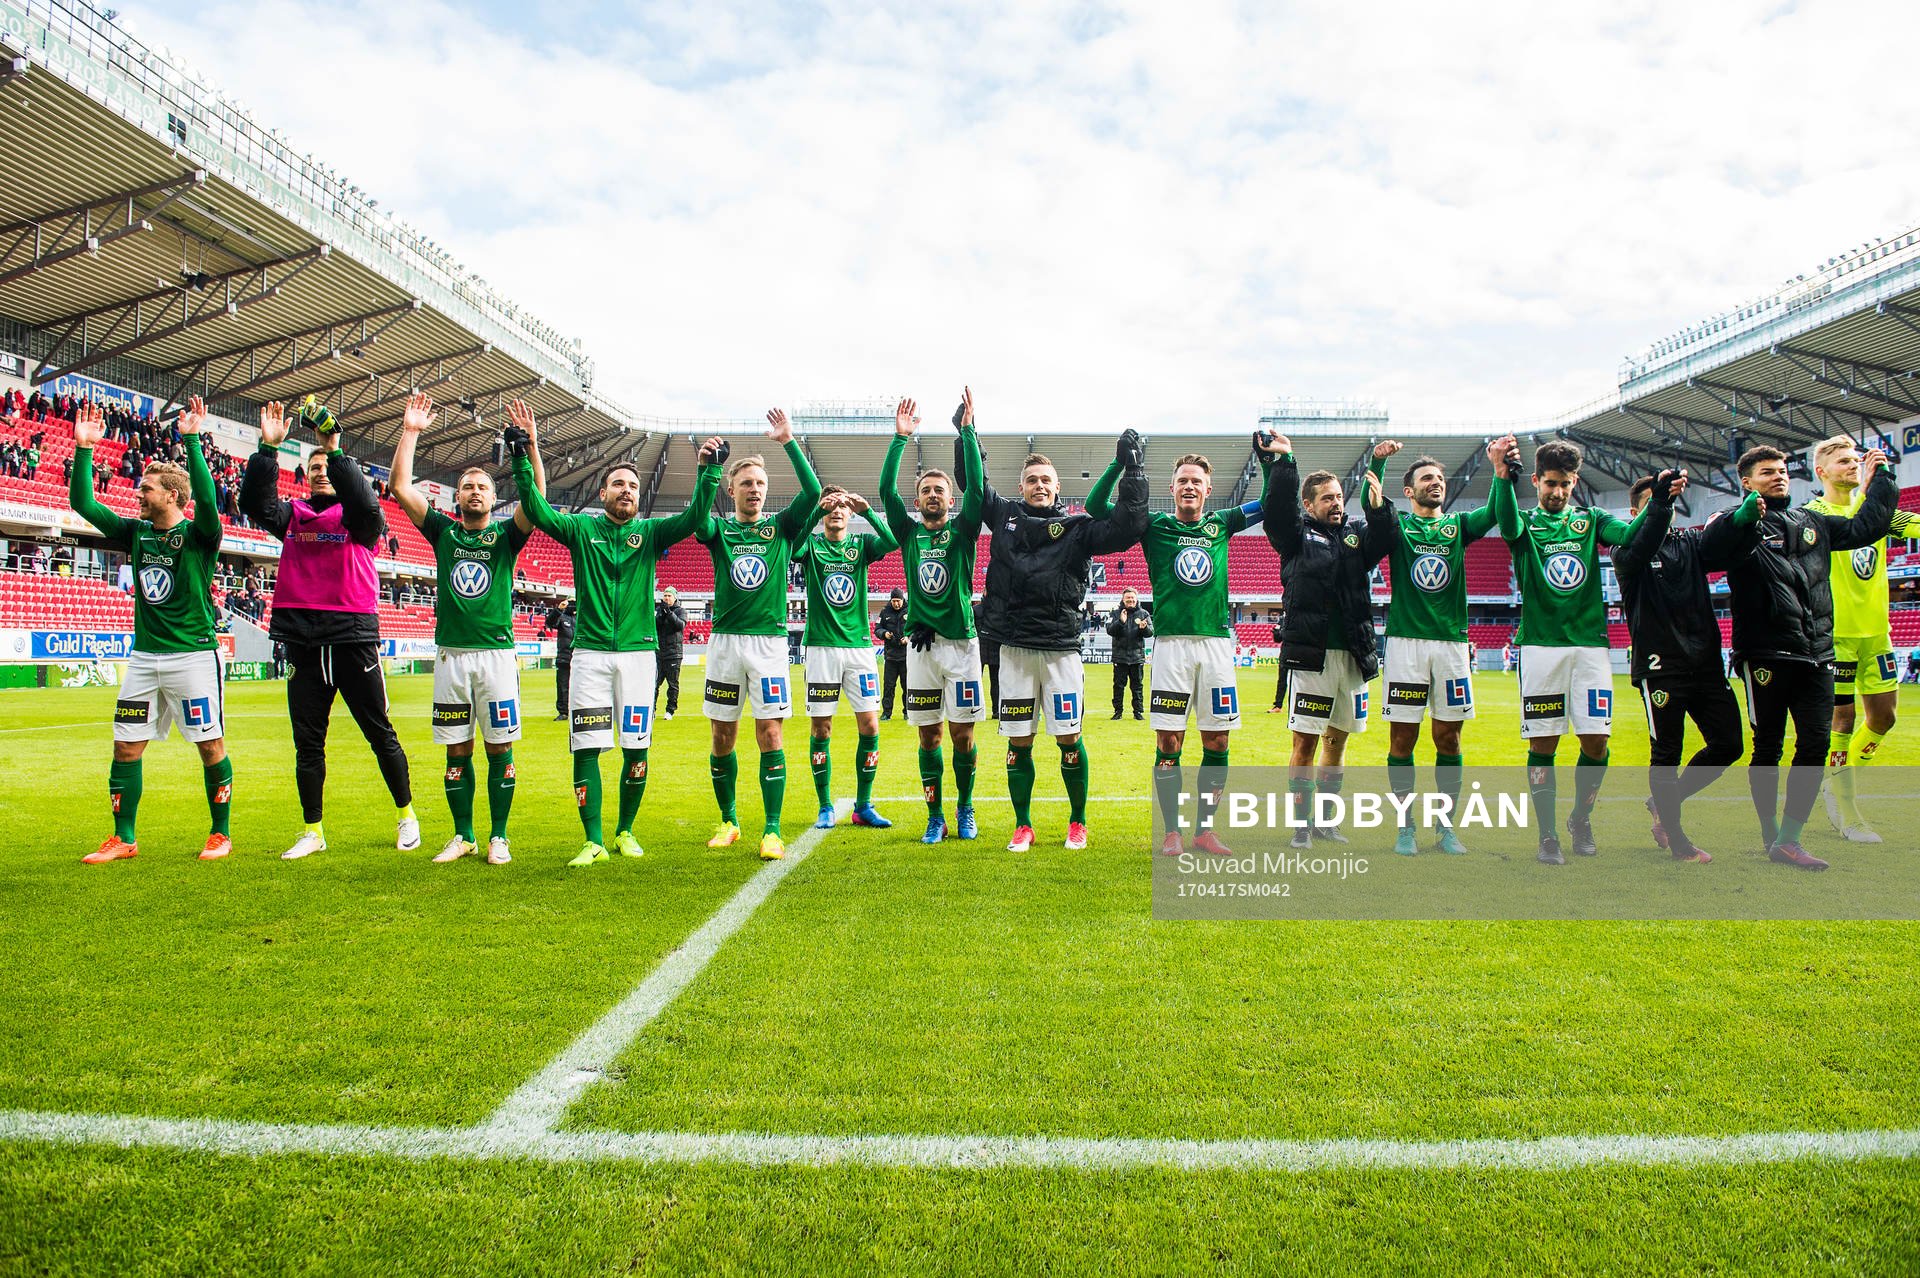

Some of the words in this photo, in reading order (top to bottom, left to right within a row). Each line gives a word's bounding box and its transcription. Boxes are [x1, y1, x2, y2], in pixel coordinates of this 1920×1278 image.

[0, 353, 17, 371] AR
[1178, 536, 1212, 548] Atteviks
[454, 548, 490, 560] Atteviks
[732, 544, 767, 554] Atteviks
[1414, 545, 1449, 555] Atteviks
[824, 563, 854, 572] Atteviks
[46, 633, 80, 654] Guld
[81, 633, 123, 658] Fågeln
[1648, 654, 1662, 670] 2
[706, 685, 737, 699] dizparc
[809, 688, 839, 698] dizparc
[1390, 688, 1427, 700] dizparc
[1152, 695, 1187, 709] dizparc
[1297, 699, 1331, 712] dizparc
[1525, 702, 1563, 713] dizparc
[1001, 704, 1032, 716] dizparc
[574, 714, 611, 728] dizparc
